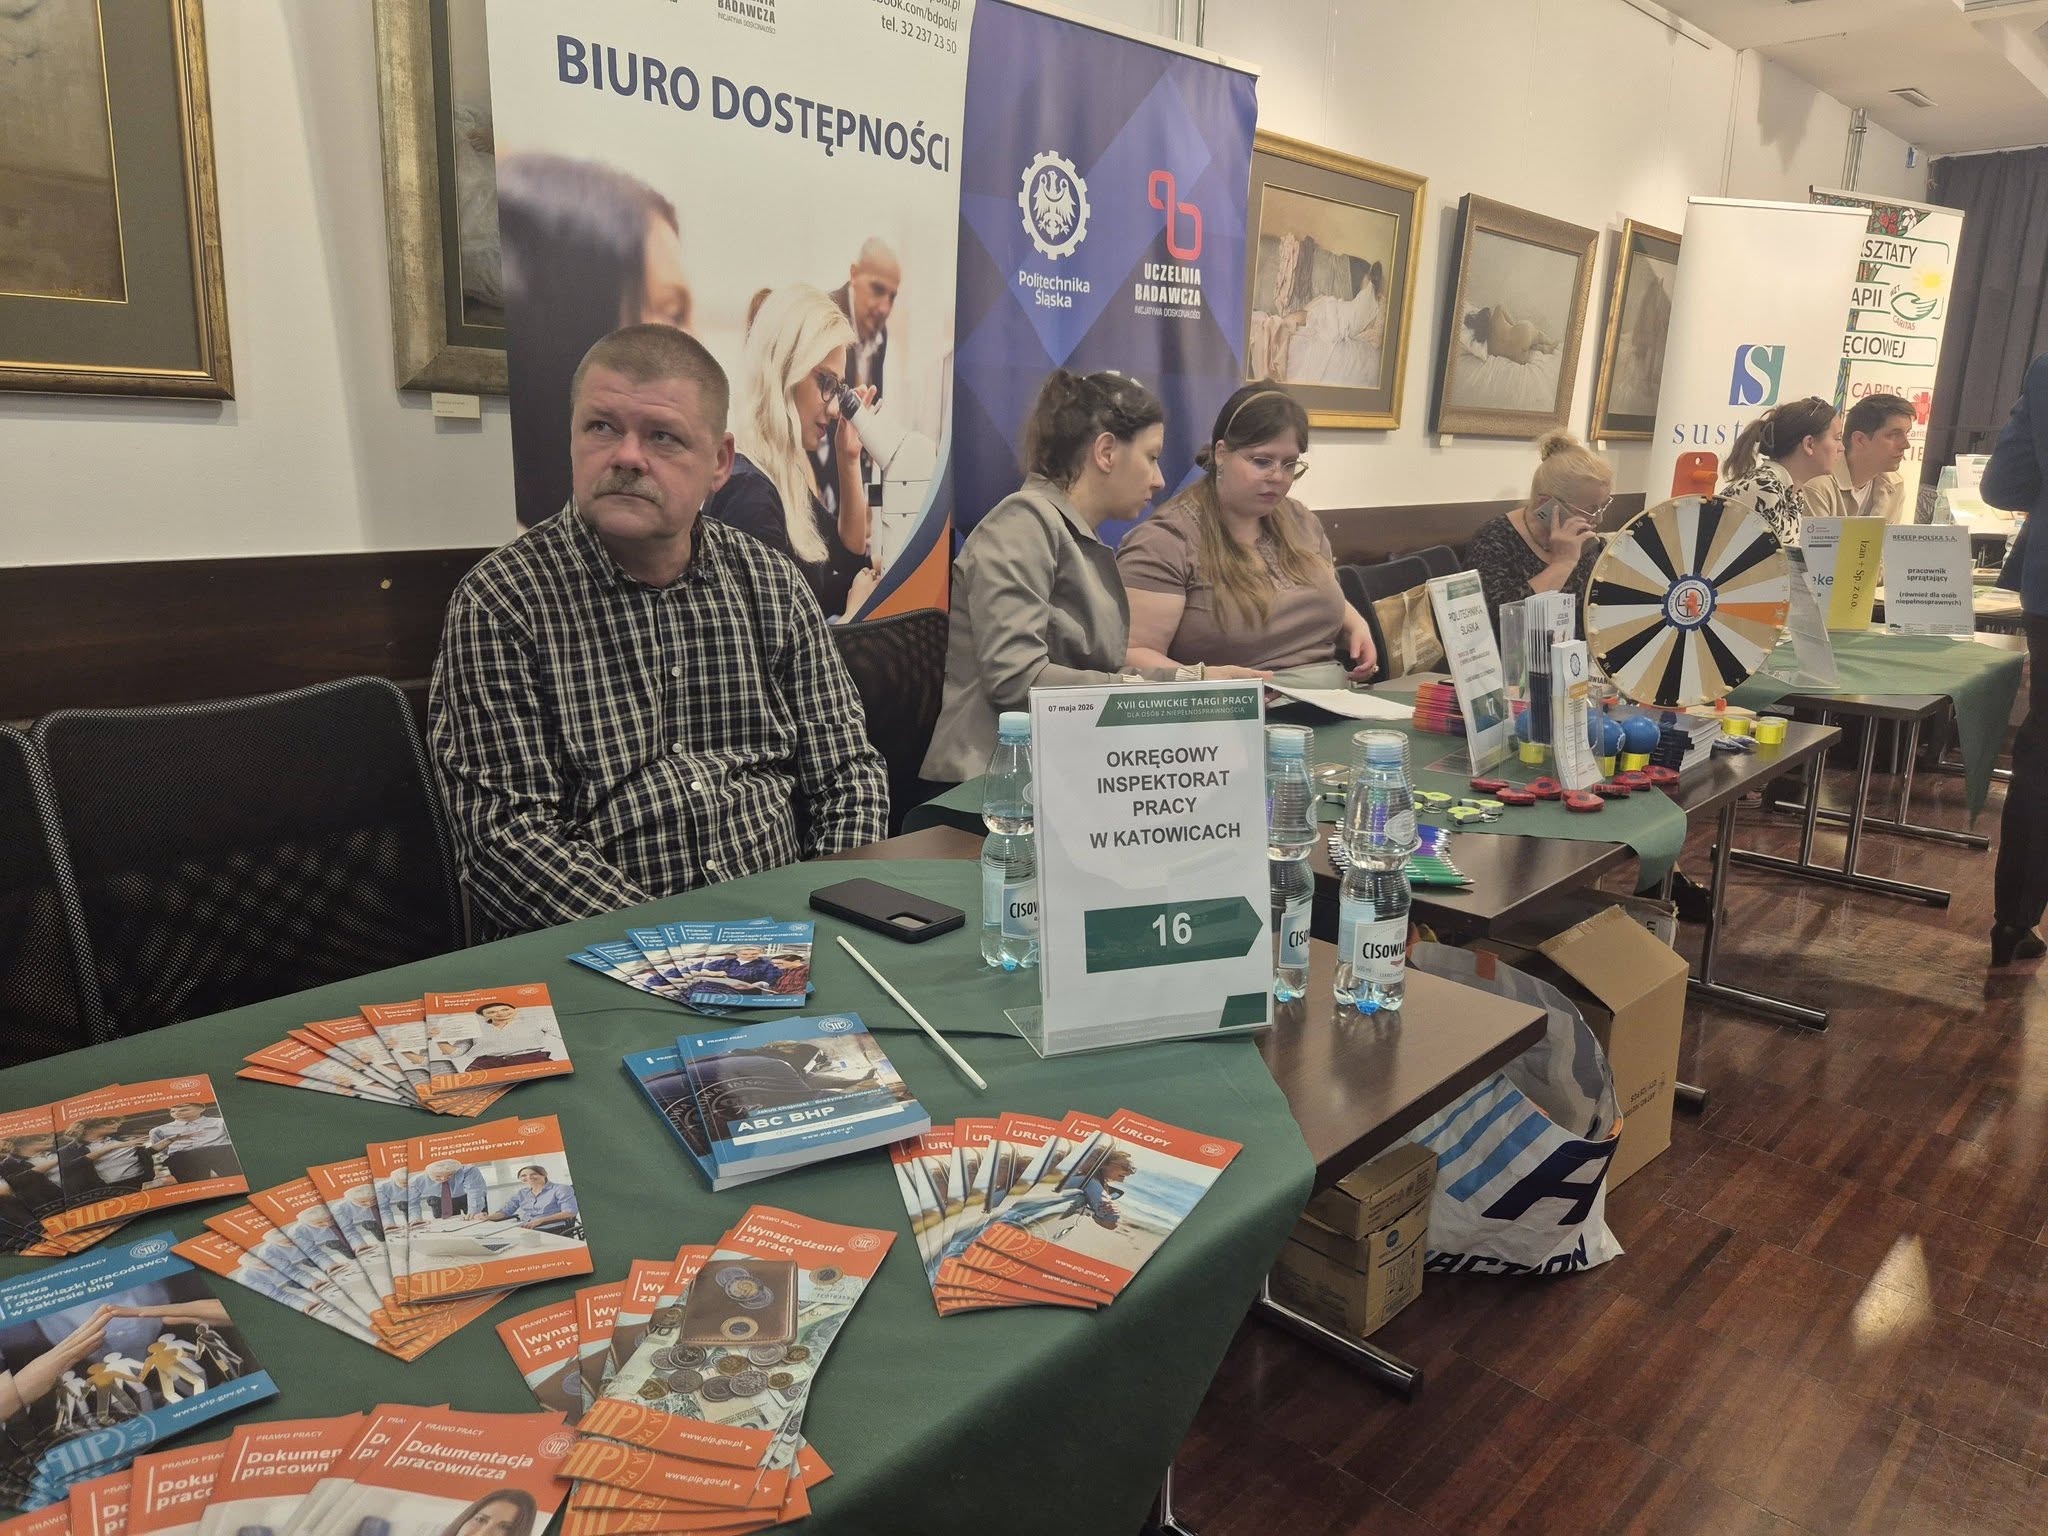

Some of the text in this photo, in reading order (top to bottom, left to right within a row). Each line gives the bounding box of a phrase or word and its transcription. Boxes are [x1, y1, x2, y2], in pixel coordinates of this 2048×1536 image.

[718, 0, 775, 24] BADAWCZA
[930, 0, 960, 11] olsl.pl
[873, 0, 957, 32] ook.com/bdpolsl
[881, 15, 956, 54] tel. 32 237 23 50
[556, 34, 950, 172] BIURO DOSTĘPNOŚCI
[1019, 271, 1090, 293] Politechnika
[1145, 263, 1201, 285] UCZELNIA
[1035, 288, 1072, 309] Śląska
[1135, 284, 1201, 306] BADAWCZA
[1851, 287, 1882, 307] APII
[1893, 315, 1915, 330] CARITAS
[1842, 335, 1906, 358] ĘCIOWEJ
[1852, 383, 1902, 398] CARITAS
[1448, 605, 1485, 623] POLITECHNIKA
[1059, 705, 1076, 713] maja
[1117, 696, 1255, 709] XVII GLIWICKIE TARGI PRACY
[1142, 709, 1160, 717] OSÓB
[1167, 707, 1245, 716] NIEPEŁNOSPRAWNOŚCIĄ
[1485, 697, 1496, 716] 17
[1106, 745, 1219, 769] OKRĘGOWY
[1096, 770, 1230, 794] INSPEKTORAT
[1133, 798, 1197, 817] PRACY
[1090, 822, 1241, 849] W KATOWICACH
[1152, 912, 1192, 947] 16
[68, 1091, 163, 1114] Nowy pracownik
[133, 1091, 201, 1107] pracodawcy
[738, 1116, 784, 1132] ABC
[789, 1106, 835, 1123] BHP
[802, 1125, 854, 1140] www.pip.gov.pl
[1119, 1126, 1172, 1147] URLOPY
[430, 1138, 488, 1152] Pracownik
[431, 1139, 525, 1157] niepełnosprawny
[757, 1214, 802, 1229] PRAWO PRACY
[747, 1225, 845, 1253] Wynagrodzenie
[756, 1240, 794, 1256] pracę
[81, 1258, 107, 1269] PRACY
[505, 1261, 566, 1274] www.pip.gov.pl
[1055, 1258, 1106, 1280] www.pip.gov.pl
[16, 1282, 87, 1308] obowiązki
[90, 1256, 169, 1285] pracodawcy
[4, 1286, 49, 1302] Prawa
[26, 1291, 85, 1313] zakresie
[88, 1281, 114, 1294] bhp
[594, 1292, 621, 1301] PRAWO
[520, 1310, 573, 1330] PRAWO PRACY
[596, 1319, 613, 1328] za
[526, 1322, 578, 1345] Wynag
[533, 1345, 552, 1356] za
[172, 1387, 247, 1419] www.pip.gov.pl
[256, 1431, 322, 1441] PRAWO PRACY
[426, 1423, 484, 1436] PRAWO PRACY
[680, 1430, 743, 1448] www.pip.gov.pl
[406, 1439, 534, 1469] Dokumentacja
[162, 1459, 199, 1470] PRAWO
[241, 1460, 336, 1480] pracown
[394, 1455, 507, 1480] pracownicza
[665, 1470, 732, 1487] www.pip.gov.pl
